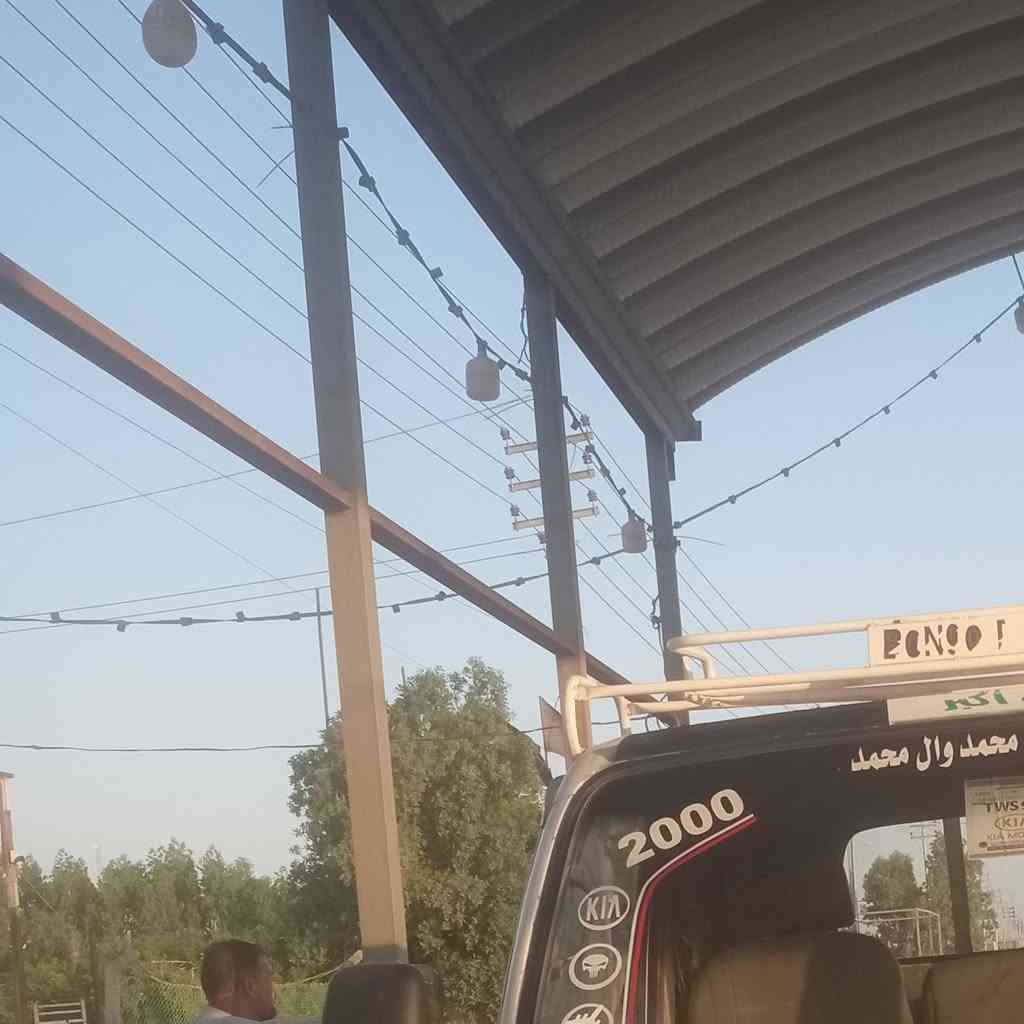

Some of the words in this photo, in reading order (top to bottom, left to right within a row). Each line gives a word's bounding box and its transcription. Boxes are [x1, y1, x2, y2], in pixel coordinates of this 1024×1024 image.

[959, 733, 1019, 758] محمد
[850, 747, 910, 772] محمد
[617, 788, 745, 869] 2000
[585, 893, 621, 922] KIA
